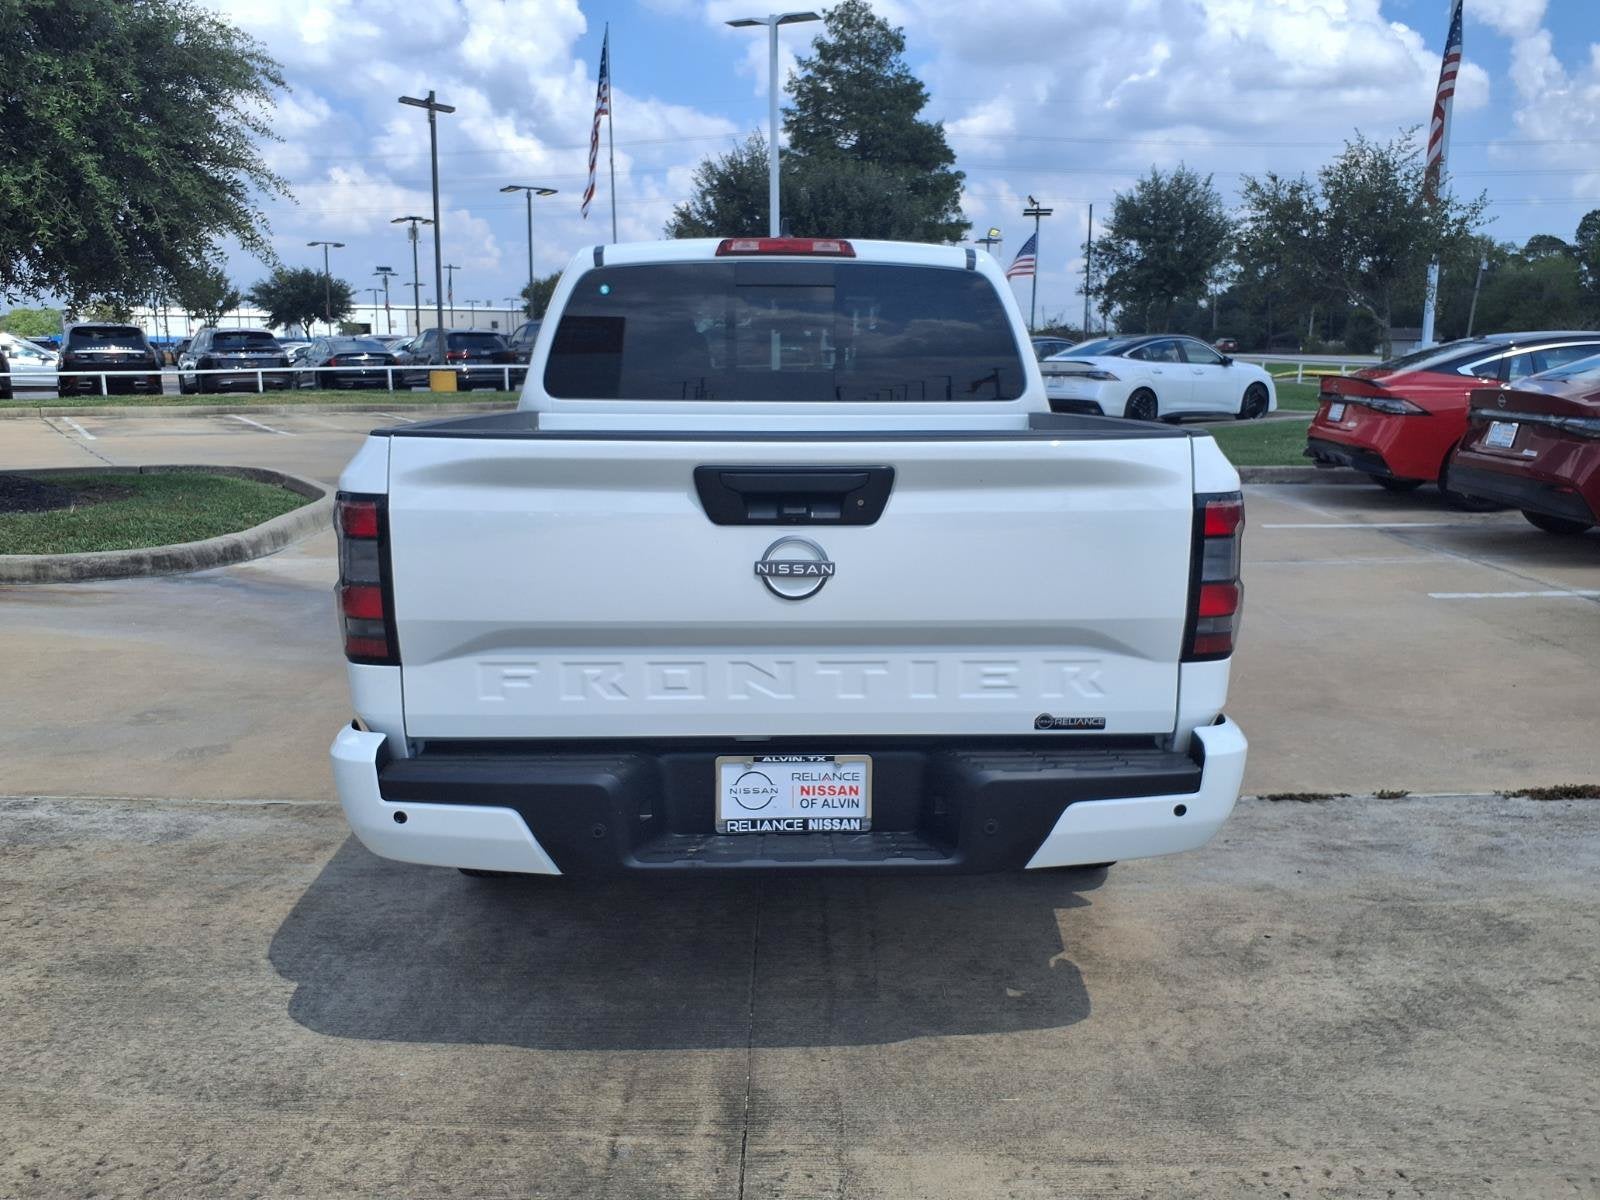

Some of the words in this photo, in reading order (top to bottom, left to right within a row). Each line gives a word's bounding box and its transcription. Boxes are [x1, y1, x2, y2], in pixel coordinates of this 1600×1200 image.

[757, 564, 833, 574] NISSAN
[477, 659, 1106, 701] FRONTIER
[1054, 717, 1105, 726] RELIANCE
[791, 772, 861, 782] RELIANCE
[729, 787, 779, 795] NISSAN
[800, 785, 860, 796] NISSAN
[800, 798, 818, 809] OF
[821, 798, 860, 809] ALVIN
[727, 820, 803, 832] RELIANCE
[808, 818, 861, 831] NISSAN
